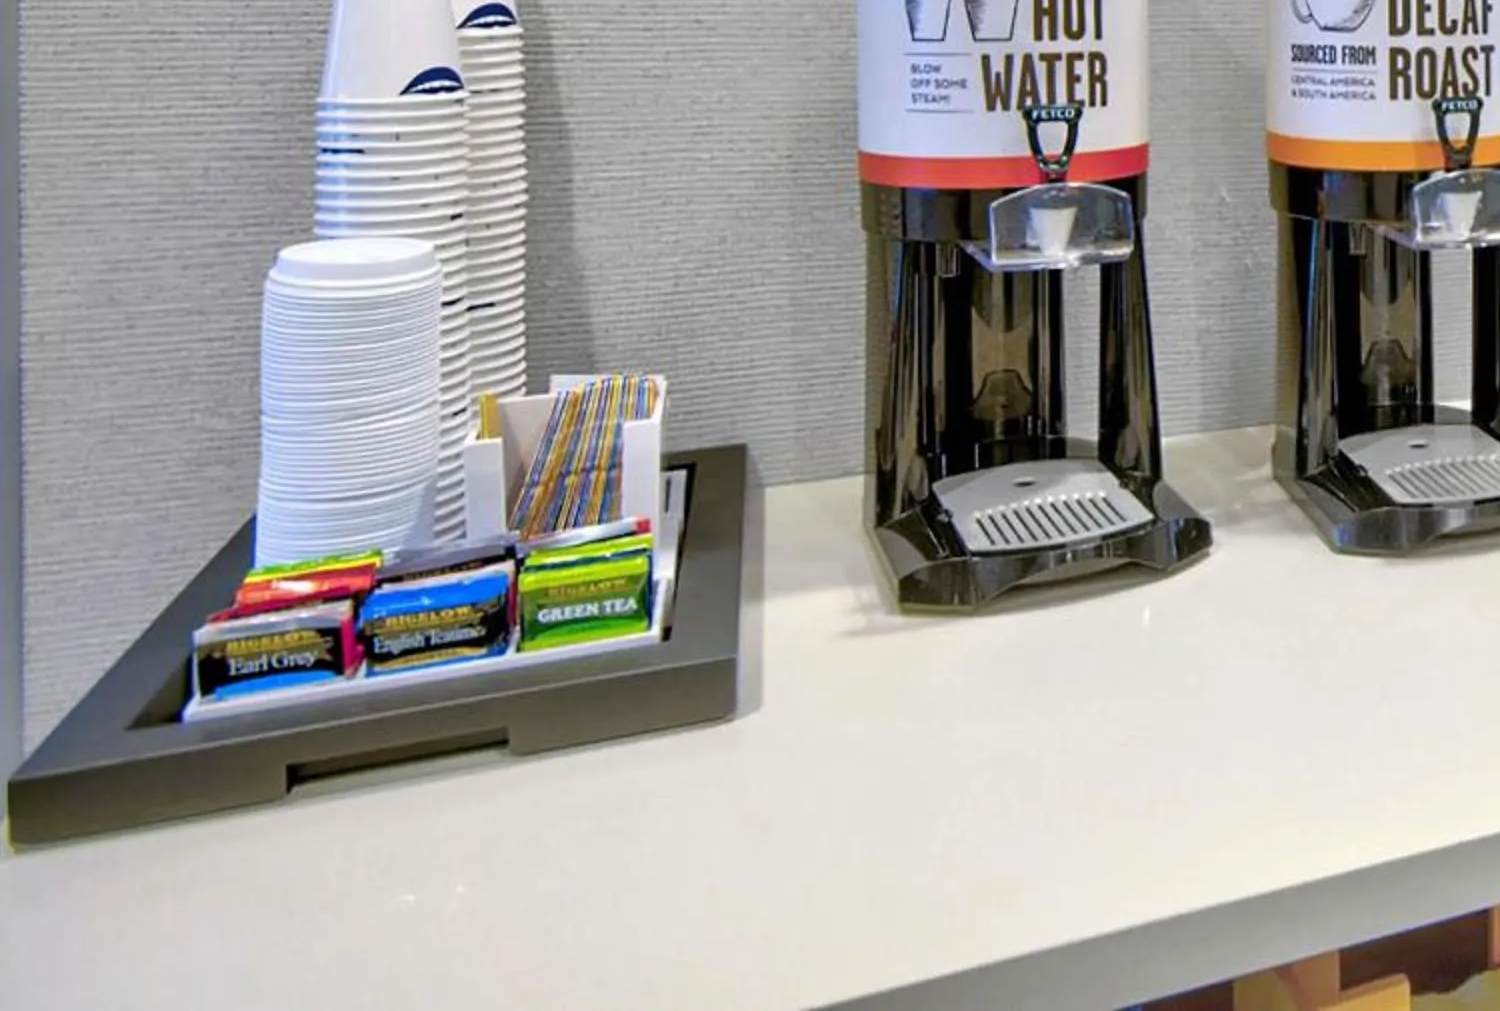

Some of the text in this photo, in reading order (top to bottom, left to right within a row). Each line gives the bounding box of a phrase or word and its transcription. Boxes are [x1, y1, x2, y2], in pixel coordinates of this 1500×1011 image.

[1291, 44, 1376, 65] SOURCED FROM
[911, 63, 942, 74] BLOW
[1389, 45, 1495, 101] ROAST
[910, 78, 968, 89] OFF SOME
[981, 51, 1108, 111] WATER
[1292, 75, 1375, 87] CENTRAL AMERICA
[1330, 90, 1376, 101] AMERICA
[1031, 108, 1075, 120] FETCO
[384, 605, 474, 629] BIGELOW
[537, 596, 638, 623] GREEN TEA
[373, 631, 422, 654] English
[229, 650, 318, 676] Earl Grey
